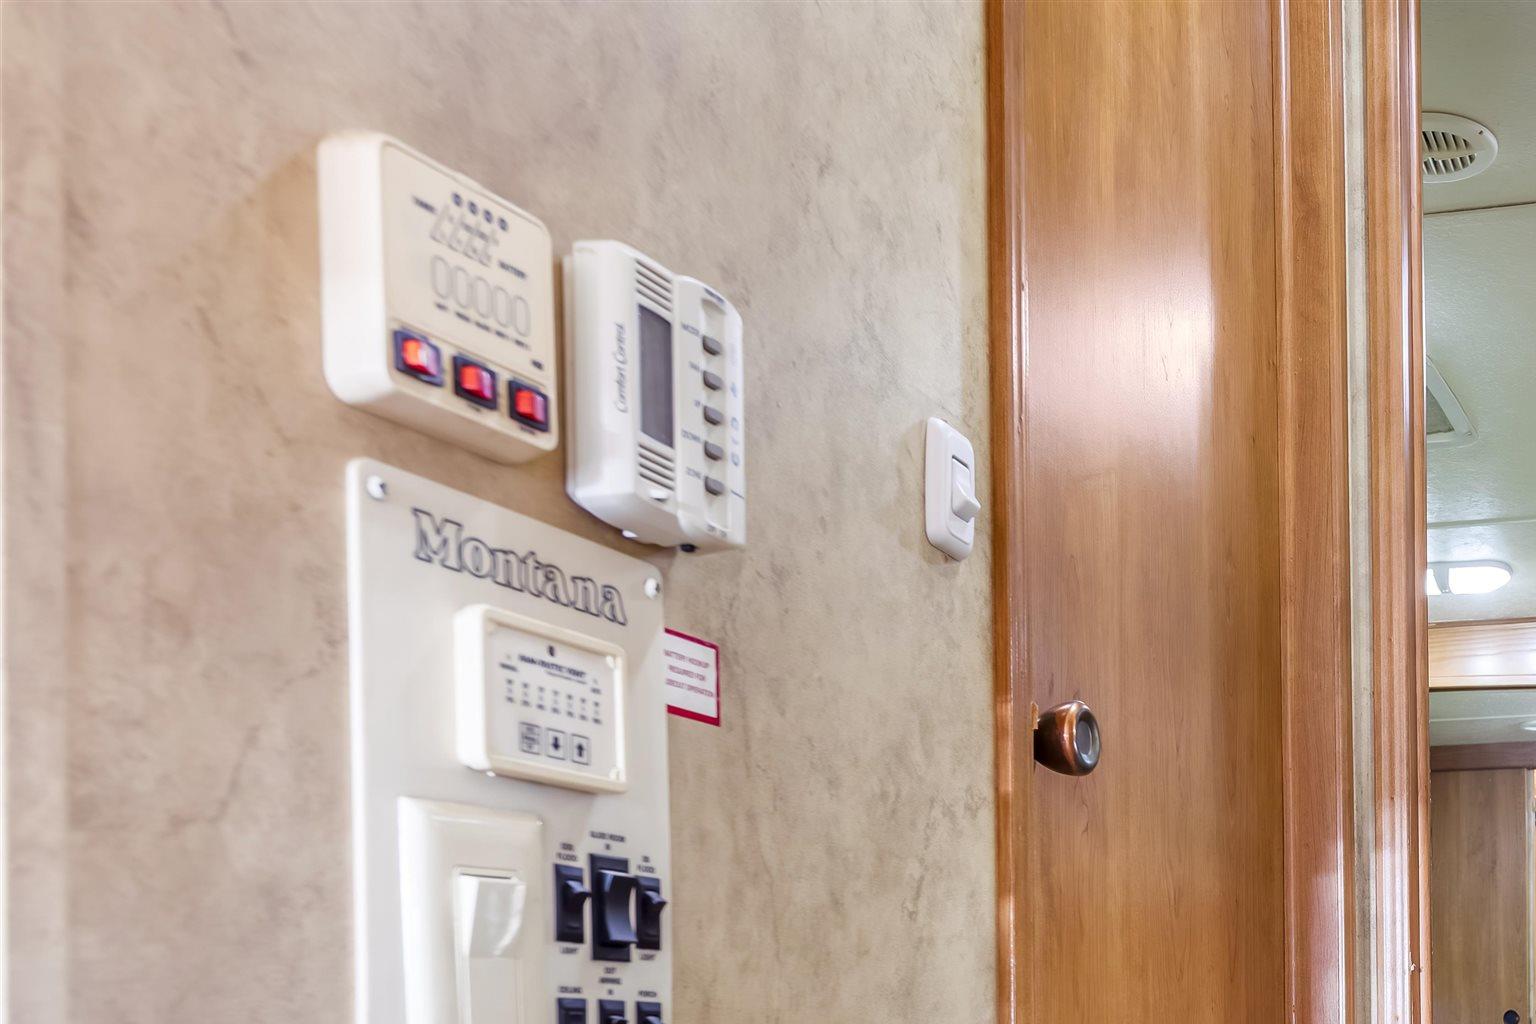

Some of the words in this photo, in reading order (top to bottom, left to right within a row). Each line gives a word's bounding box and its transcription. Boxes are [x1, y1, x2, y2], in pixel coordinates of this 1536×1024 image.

[611, 321, 628, 366] Control
[613, 366, 628, 414] Comfort
[411, 507, 628, 626] Montana
